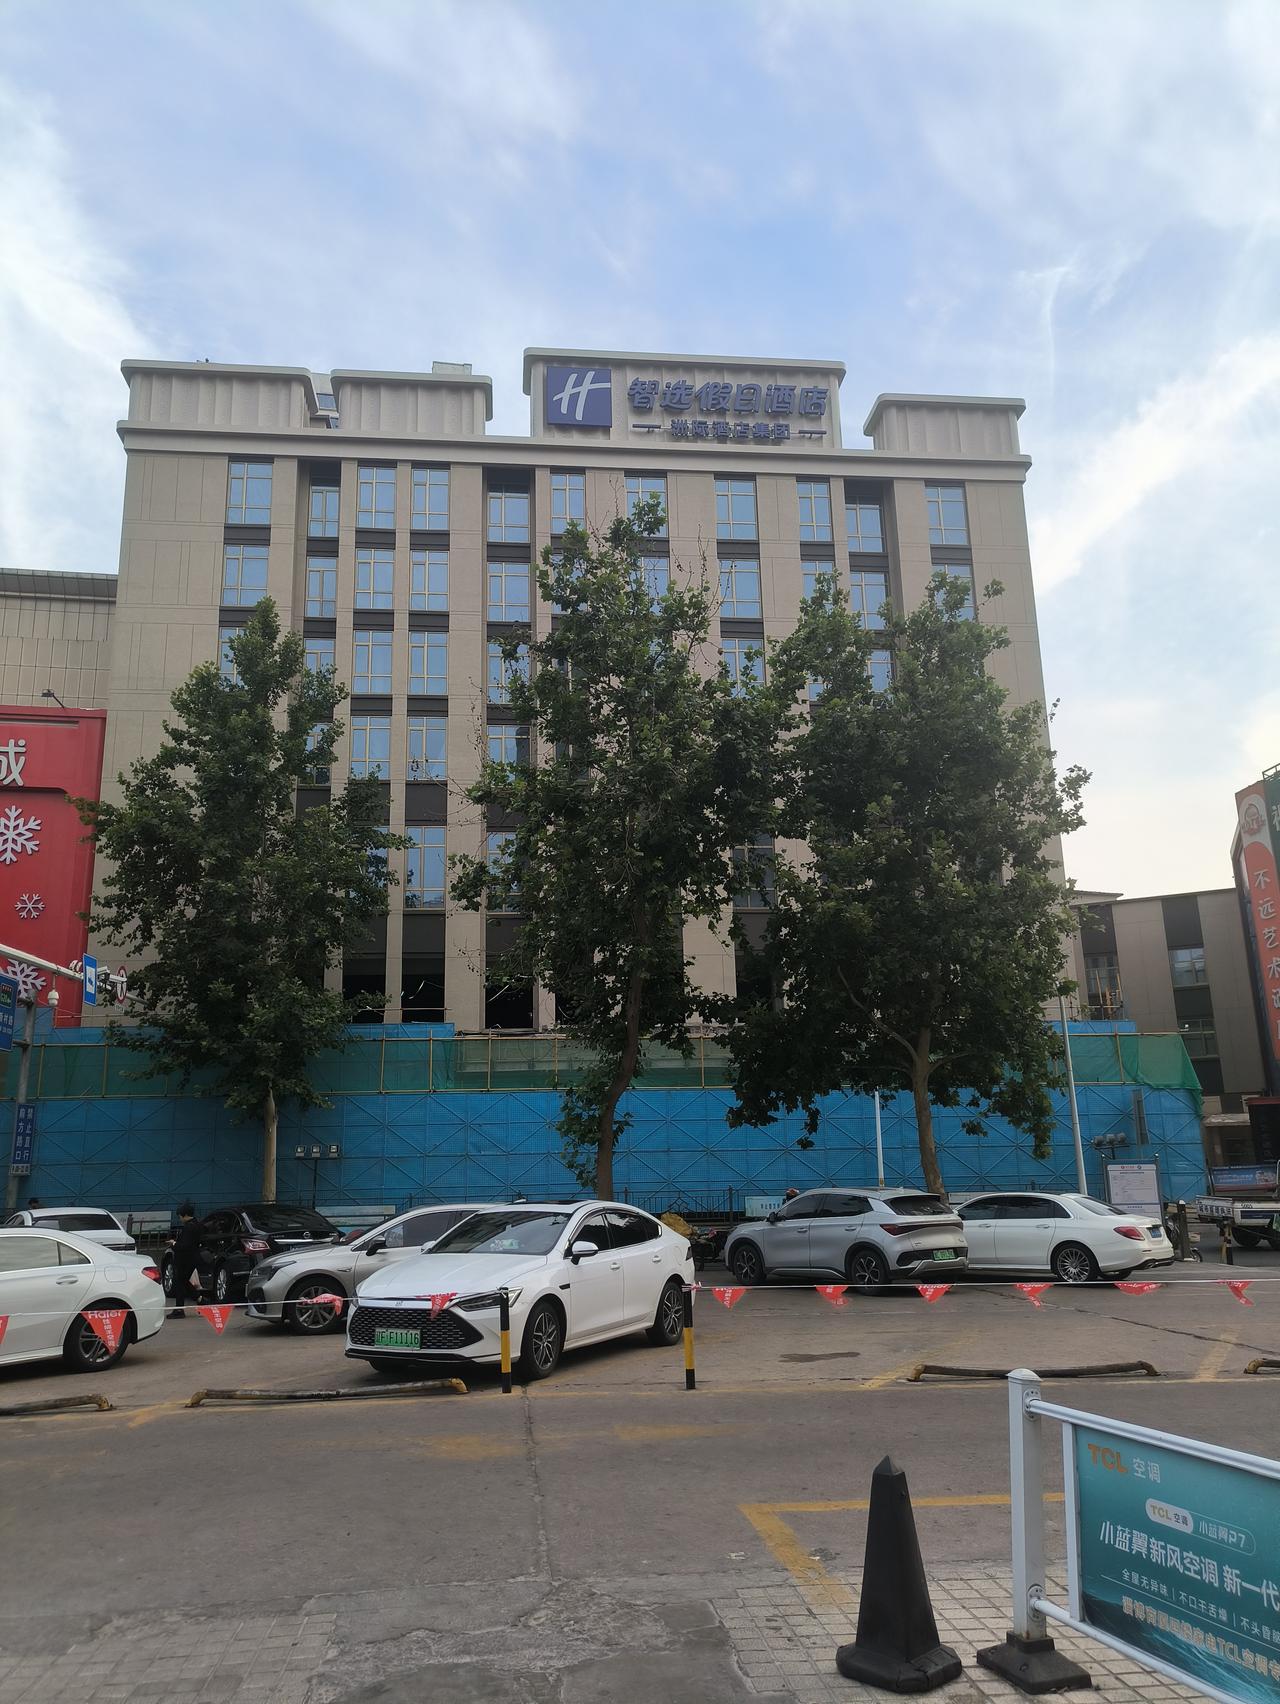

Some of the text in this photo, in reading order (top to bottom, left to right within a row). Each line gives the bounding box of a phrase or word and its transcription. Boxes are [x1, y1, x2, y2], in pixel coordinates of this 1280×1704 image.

[627, 376, 829, 416] 智选假日酒店
[671, 419, 791, 440] 洲际酒店集团
[1088, 1443, 1161, 1483] TCL 空调
[1150, 1504, 1189, 1527] TCL 空调
[1100, 1520, 1280, 1611] 小蓝翼新风空调 新一代
